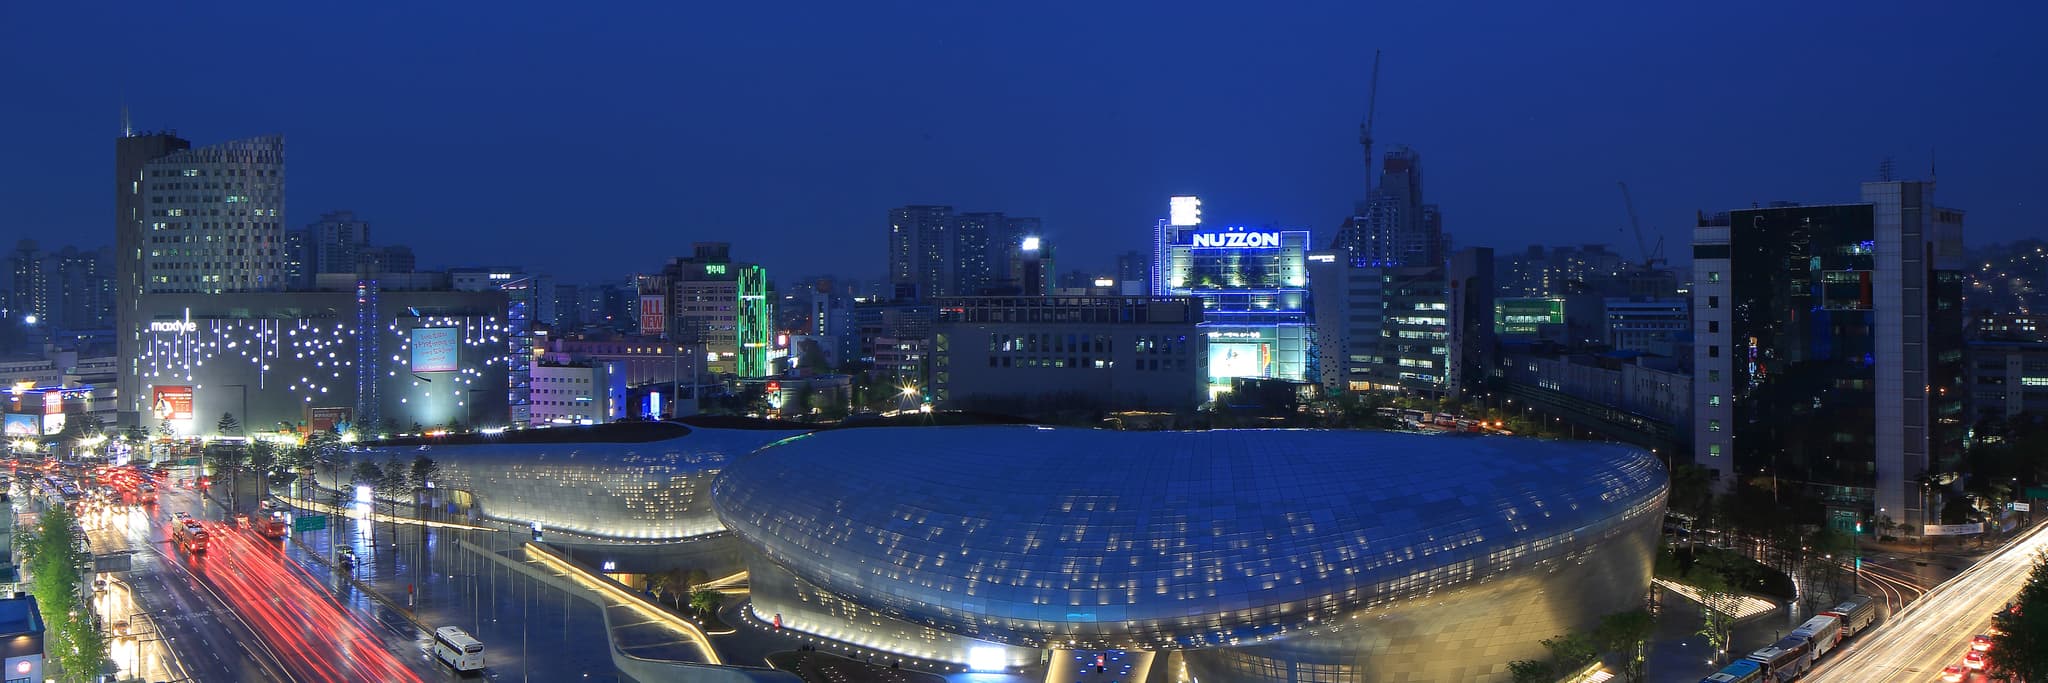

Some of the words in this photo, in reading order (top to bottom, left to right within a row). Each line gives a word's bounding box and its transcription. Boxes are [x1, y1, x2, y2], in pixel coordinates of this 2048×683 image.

[1193, 229, 1279, 247] NUZZON
[642, 299, 663, 315] ALL
[642, 316, 663, 328] NEW
